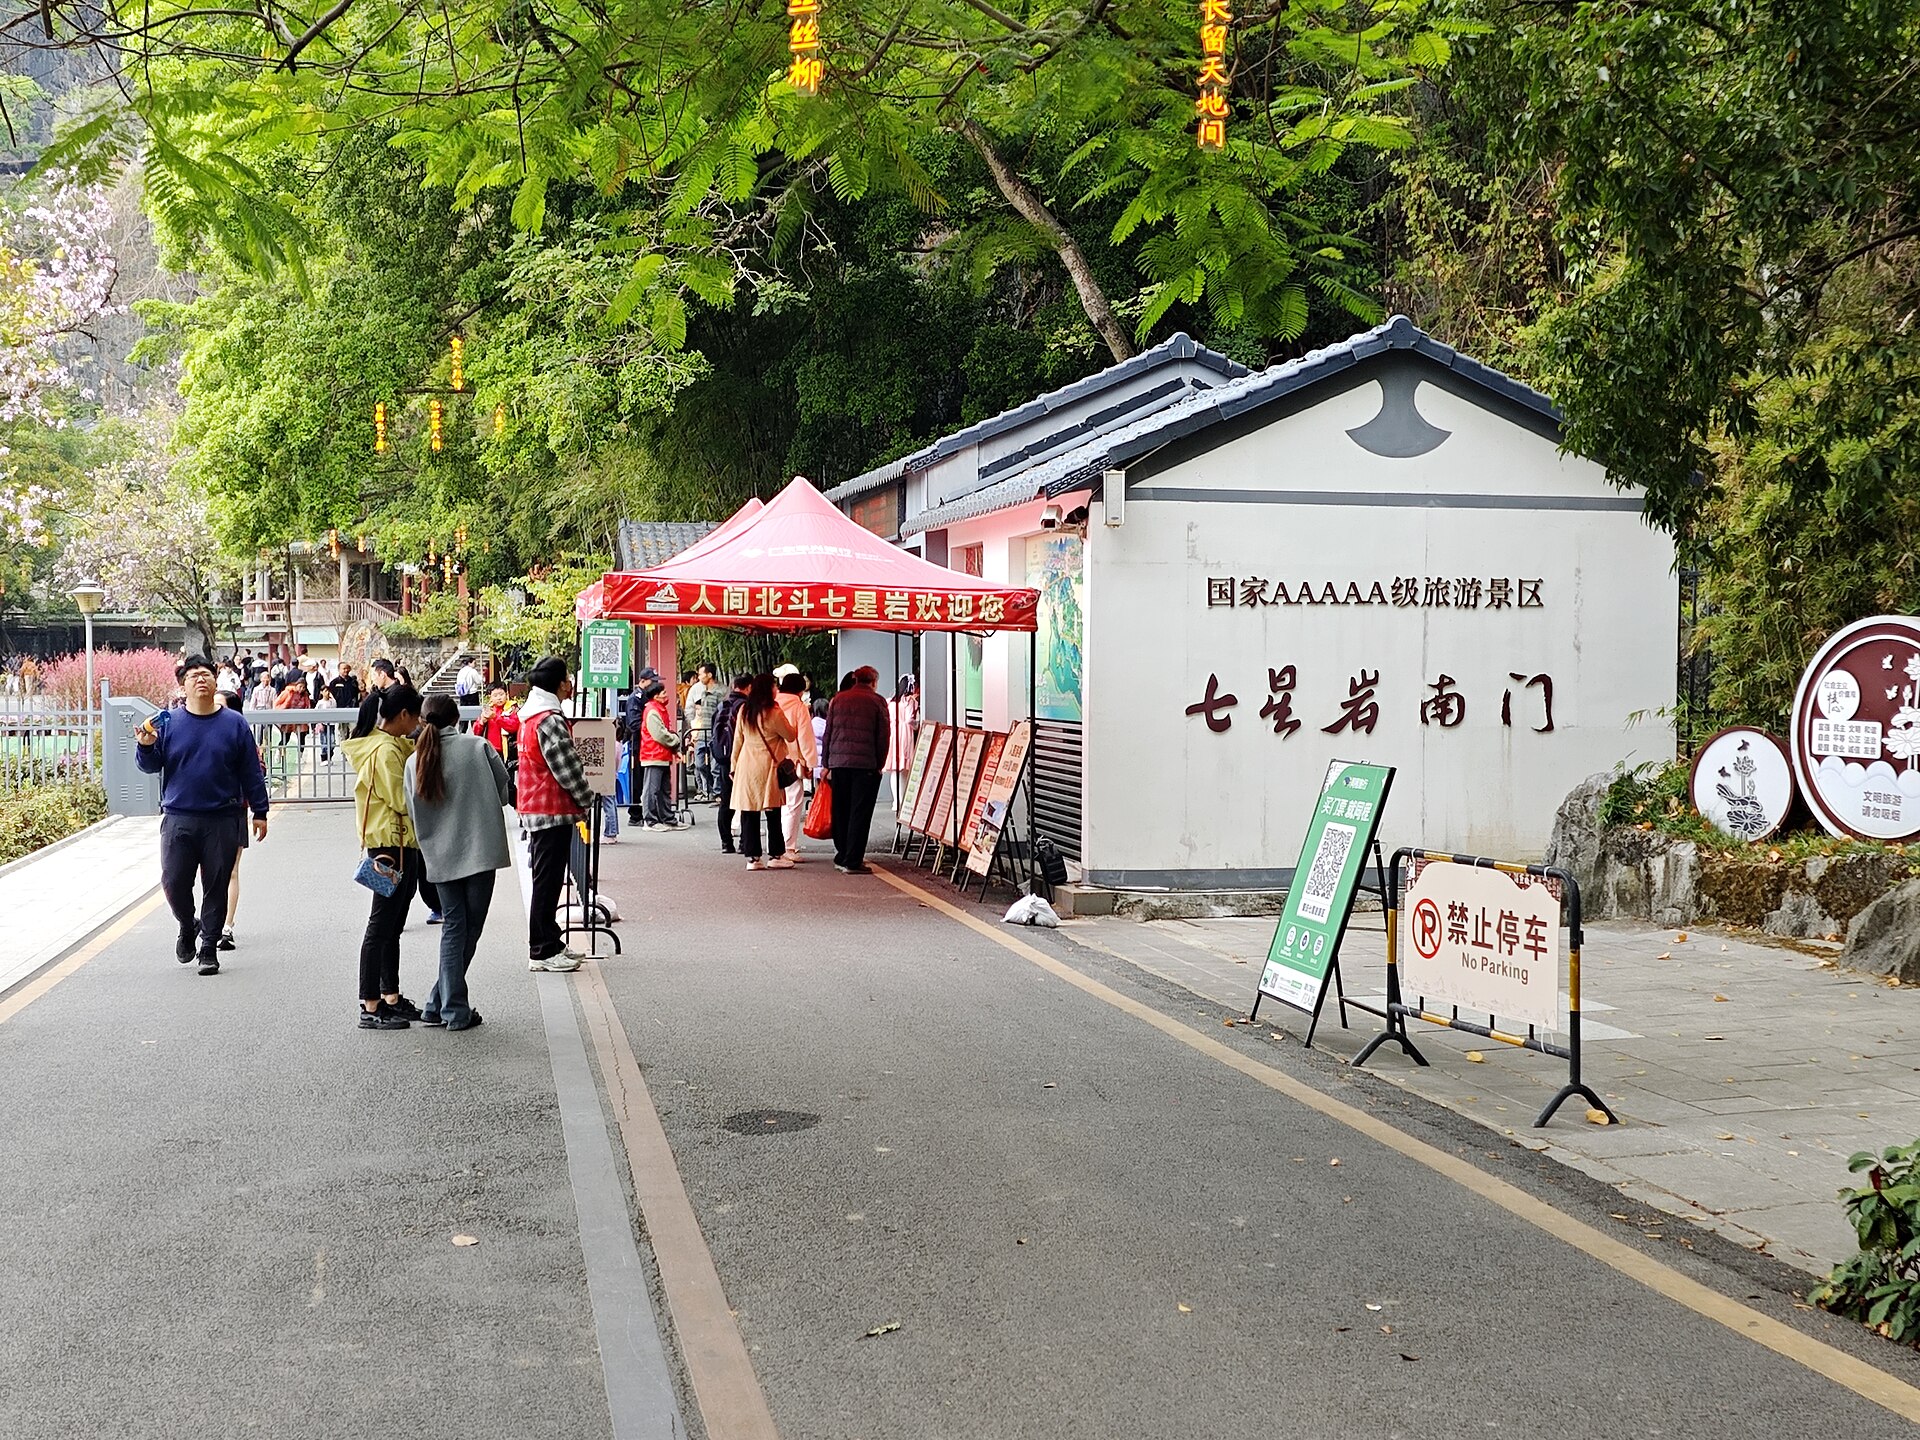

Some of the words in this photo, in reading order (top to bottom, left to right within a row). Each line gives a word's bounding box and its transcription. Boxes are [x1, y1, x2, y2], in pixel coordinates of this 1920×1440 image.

[1197, 0, 1232, 149] 长留天地间
[689, 586, 1005, 623] 人间北斗七星岩欢迎您
[1206, 576, 1544, 609] 国家AAAAA级旅游景区
[1185, 665, 1555, 740] 七星岩南门
[1862, 805, 1901, 822] 请勿吸烟
[1863, 790, 1902, 807] 文明旅游
[1447, 900, 1548, 961] 禁止停车
[1461, 952, 1477, 970] No
[1481, 956, 1529, 985] Parking
